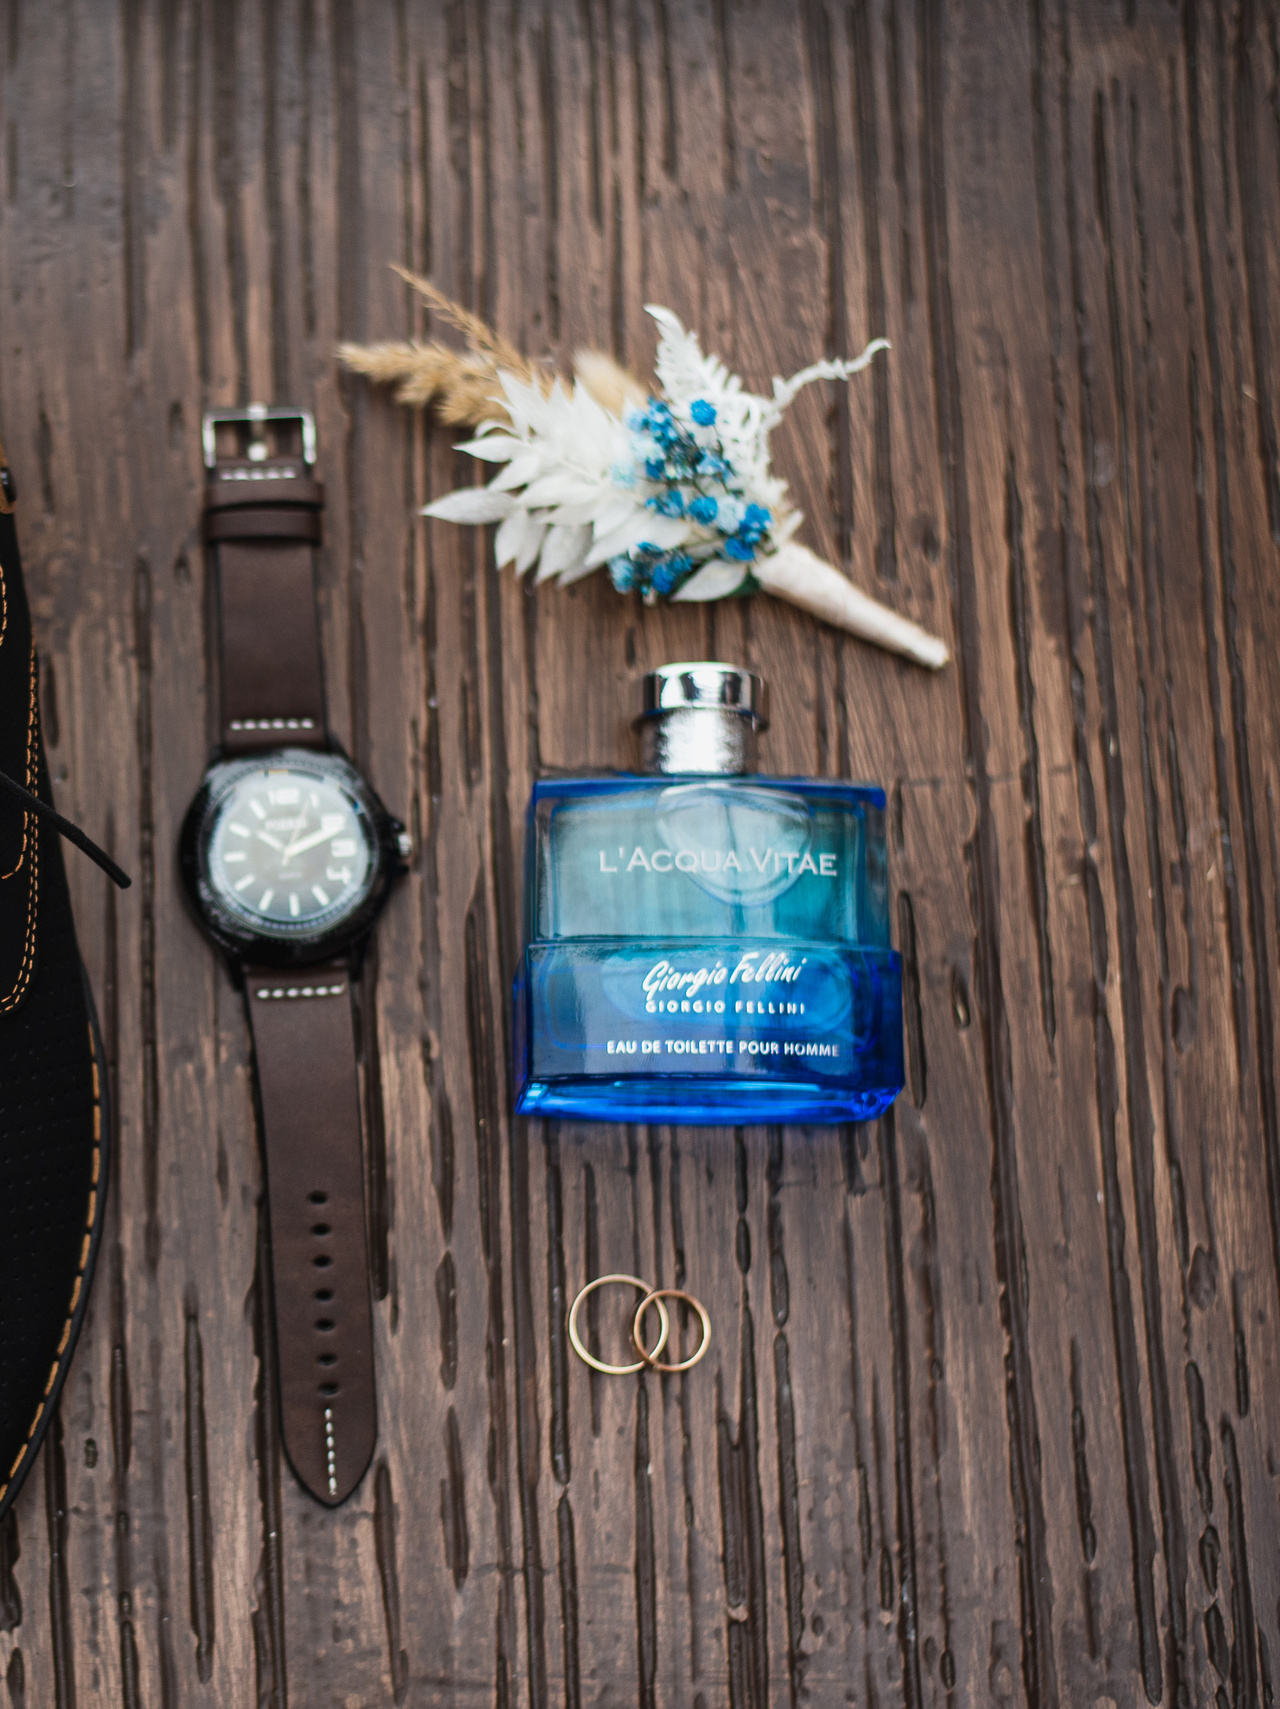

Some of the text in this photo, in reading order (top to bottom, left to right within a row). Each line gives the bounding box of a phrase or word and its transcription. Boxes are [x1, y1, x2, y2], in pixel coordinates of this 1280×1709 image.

[749, 847, 838, 877] VITAE
[642, 951, 808, 1001] Giorgio Fellini
[645, 999, 805, 1015] GIORGIO FELLINI
[606, 1039, 840, 1057] EAU DE TOILETTE POUR HOMME
